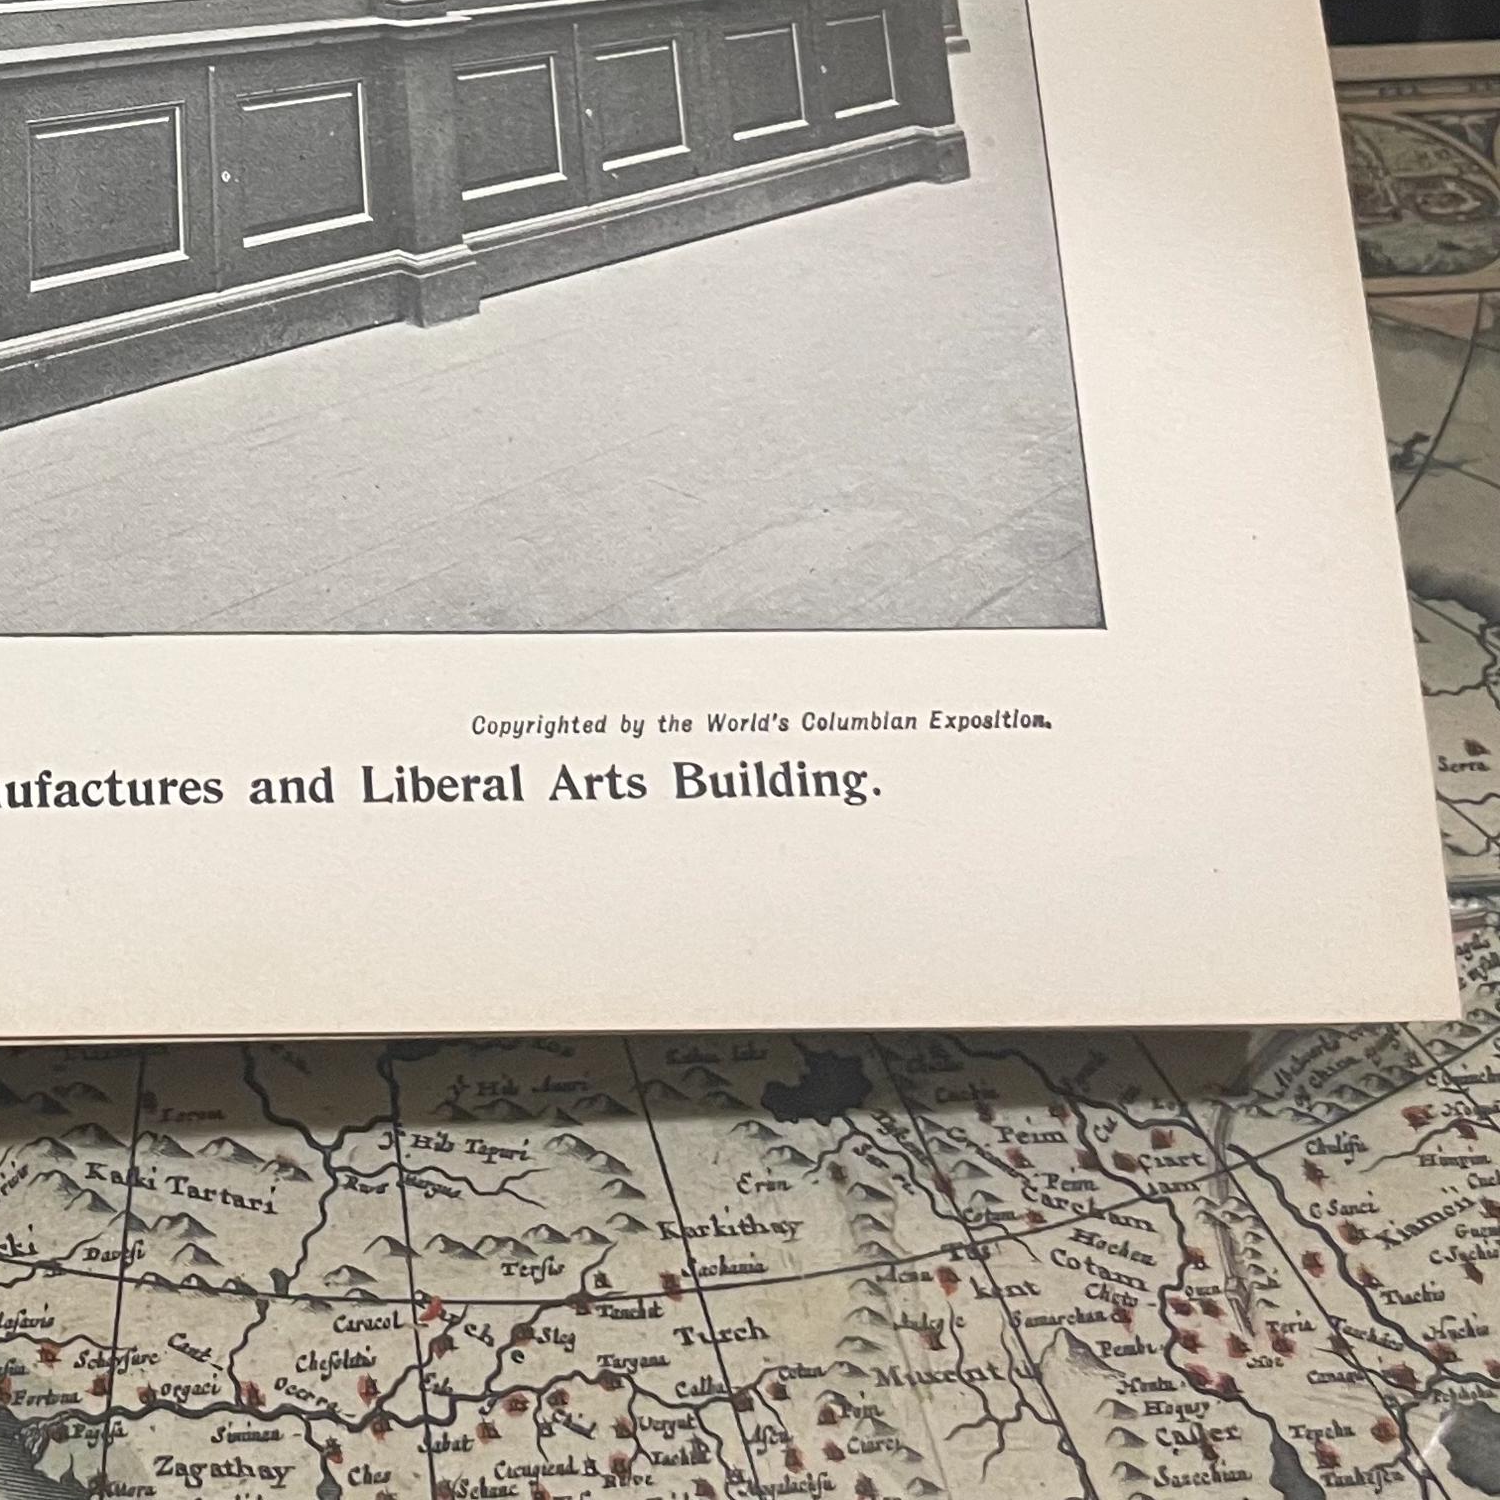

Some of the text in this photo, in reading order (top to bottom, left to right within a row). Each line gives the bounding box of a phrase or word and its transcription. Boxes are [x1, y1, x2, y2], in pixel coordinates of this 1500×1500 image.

[472, 708, 1052, 739] Copyrighted by the World's Columbian Exposition.
[249, 766, 334, 805] and
[362, 763, 524, 804] Liberal
[549, 764, 647, 801] Arts
[673, 760, 881, 806] Building.
[165, 1175, 279, 1215] Tartari
